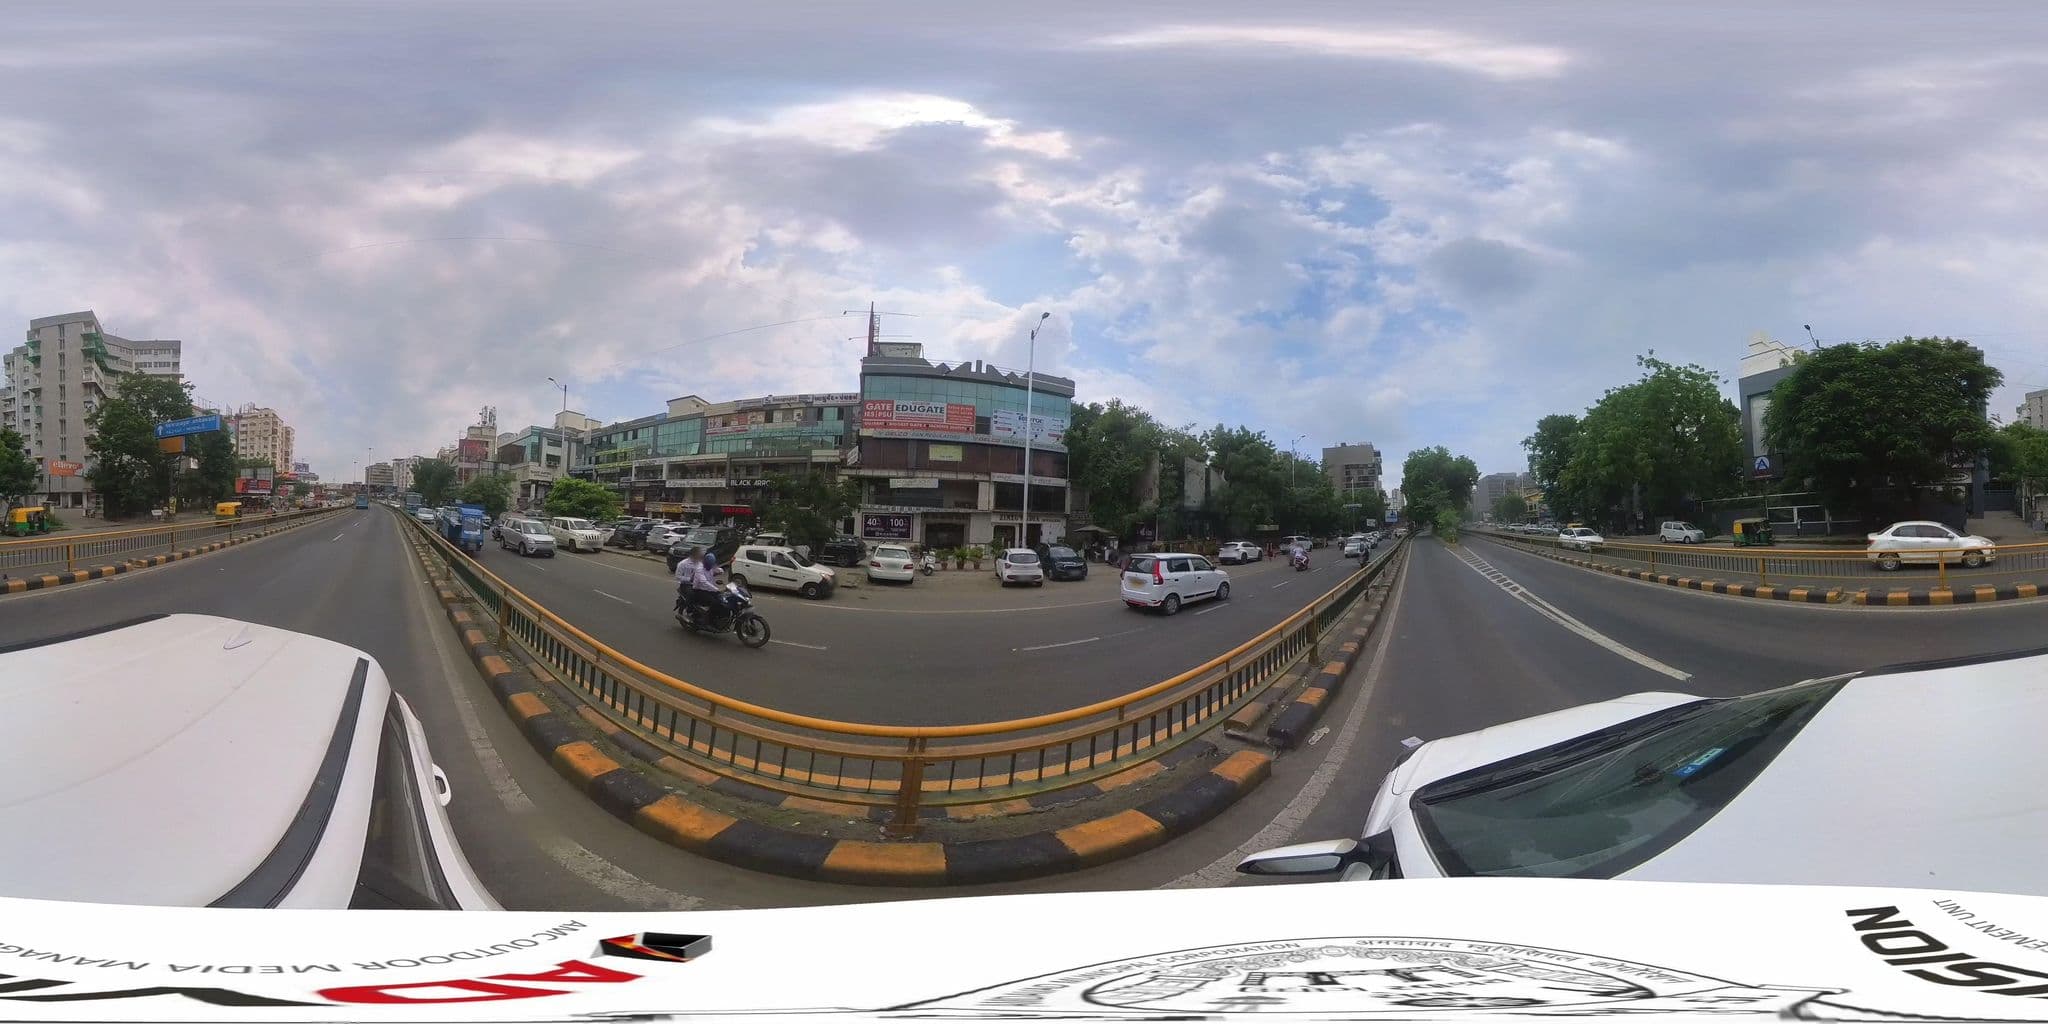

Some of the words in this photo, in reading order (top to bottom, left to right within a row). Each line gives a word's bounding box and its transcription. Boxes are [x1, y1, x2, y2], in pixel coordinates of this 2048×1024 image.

[865, 402, 893, 411] GATE
[895, 404, 945, 414] EDUGATE
[730, 479, 752, 488] BLACK
